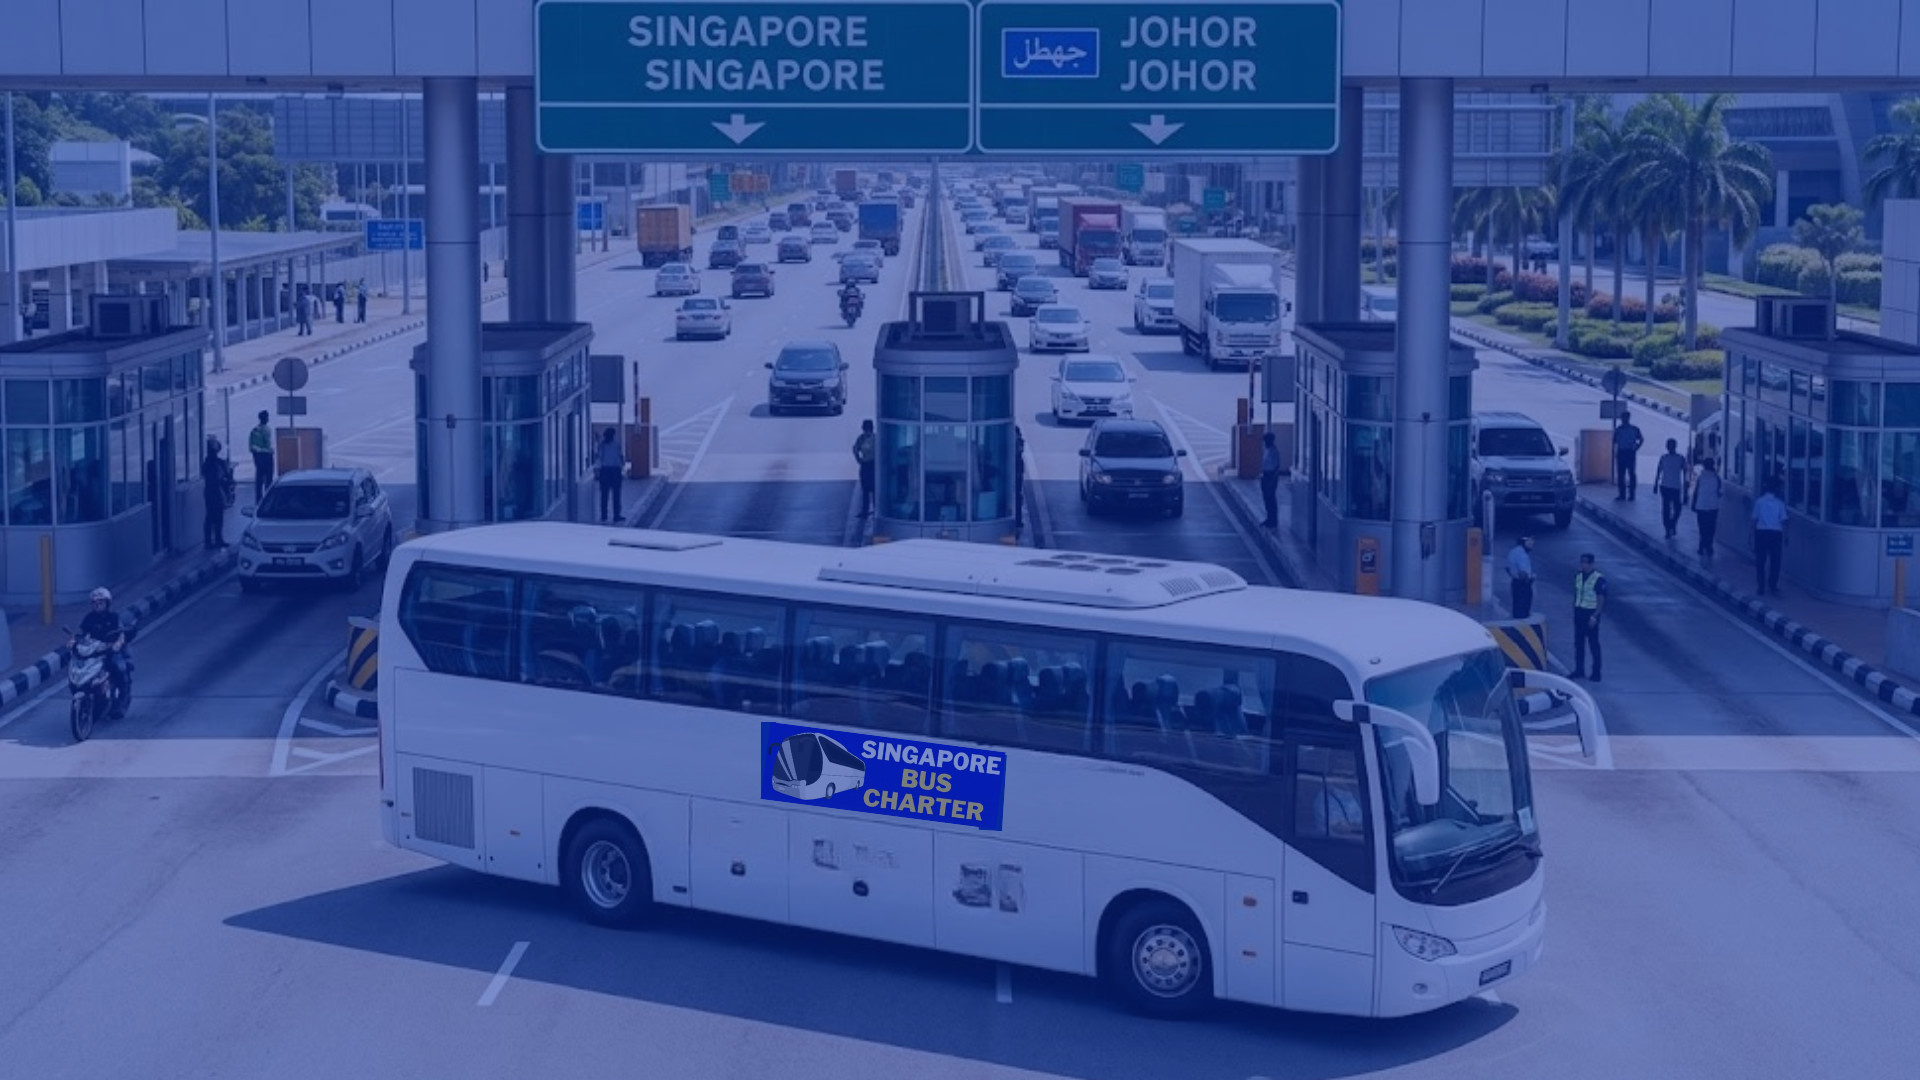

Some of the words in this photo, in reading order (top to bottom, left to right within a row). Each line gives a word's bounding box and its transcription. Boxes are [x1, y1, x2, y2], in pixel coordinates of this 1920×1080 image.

[628, 15, 868, 48] SINGAPORE
[1120, 15, 1257, 48] JOHOR
[645, 58, 885, 91] SINGAPORE
[1120, 59, 1257, 92] JOHOR
[861, 740, 1002, 776] SINGAPORE
[901, 768, 953, 793] BUS
[863, 788, 984, 821] CHARTER
